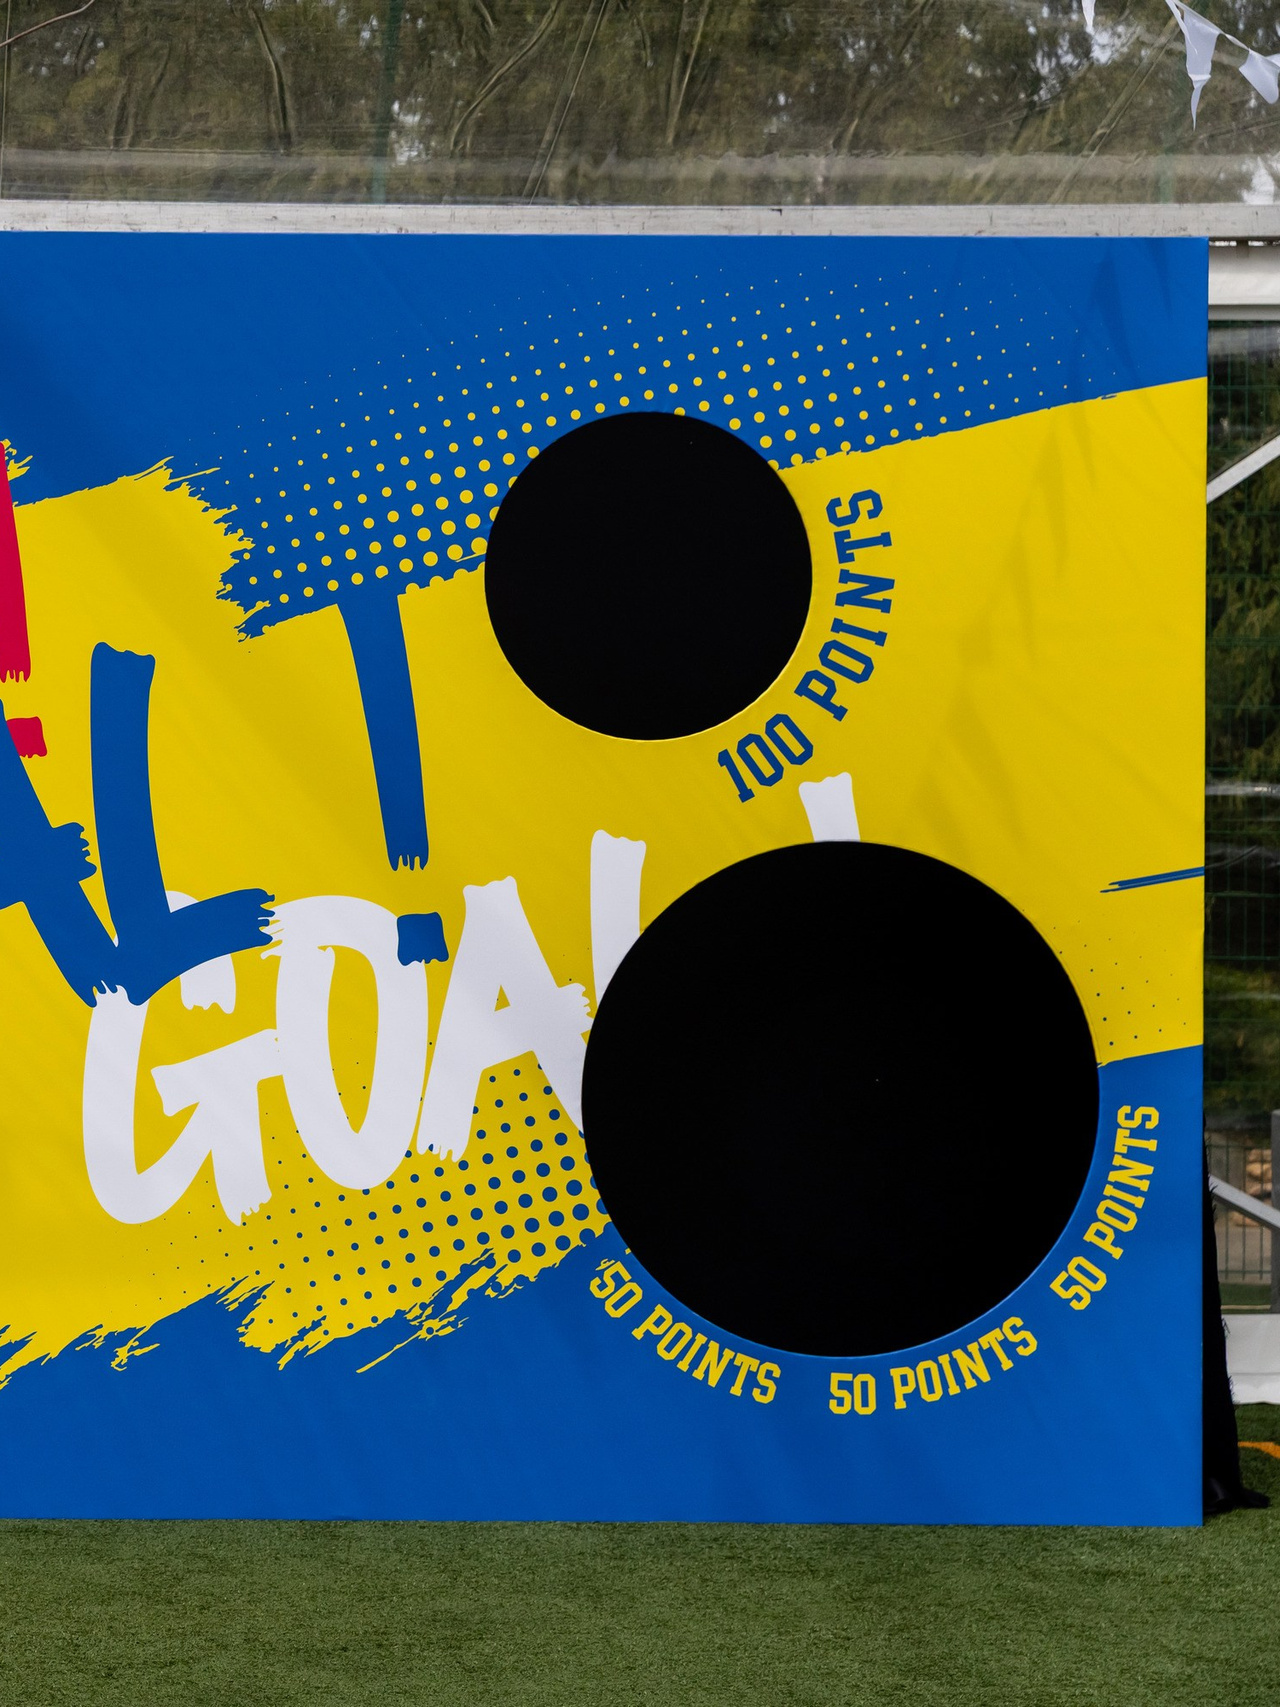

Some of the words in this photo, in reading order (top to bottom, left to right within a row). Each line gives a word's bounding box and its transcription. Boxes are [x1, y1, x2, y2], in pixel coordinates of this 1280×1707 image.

[719, 715, 812, 801] 100
[796, 490, 894, 720] POINTS
[1051, 1257, 1106, 1309] 50
[1085, 1106, 1159, 1258] POINTS
[590, 1261, 642, 1317] 50
[632, 1304, 781, 1403] POINTS
[830, 1373, 876, 1414] 50
[890, 1317, 1037, 1409] POINTS
